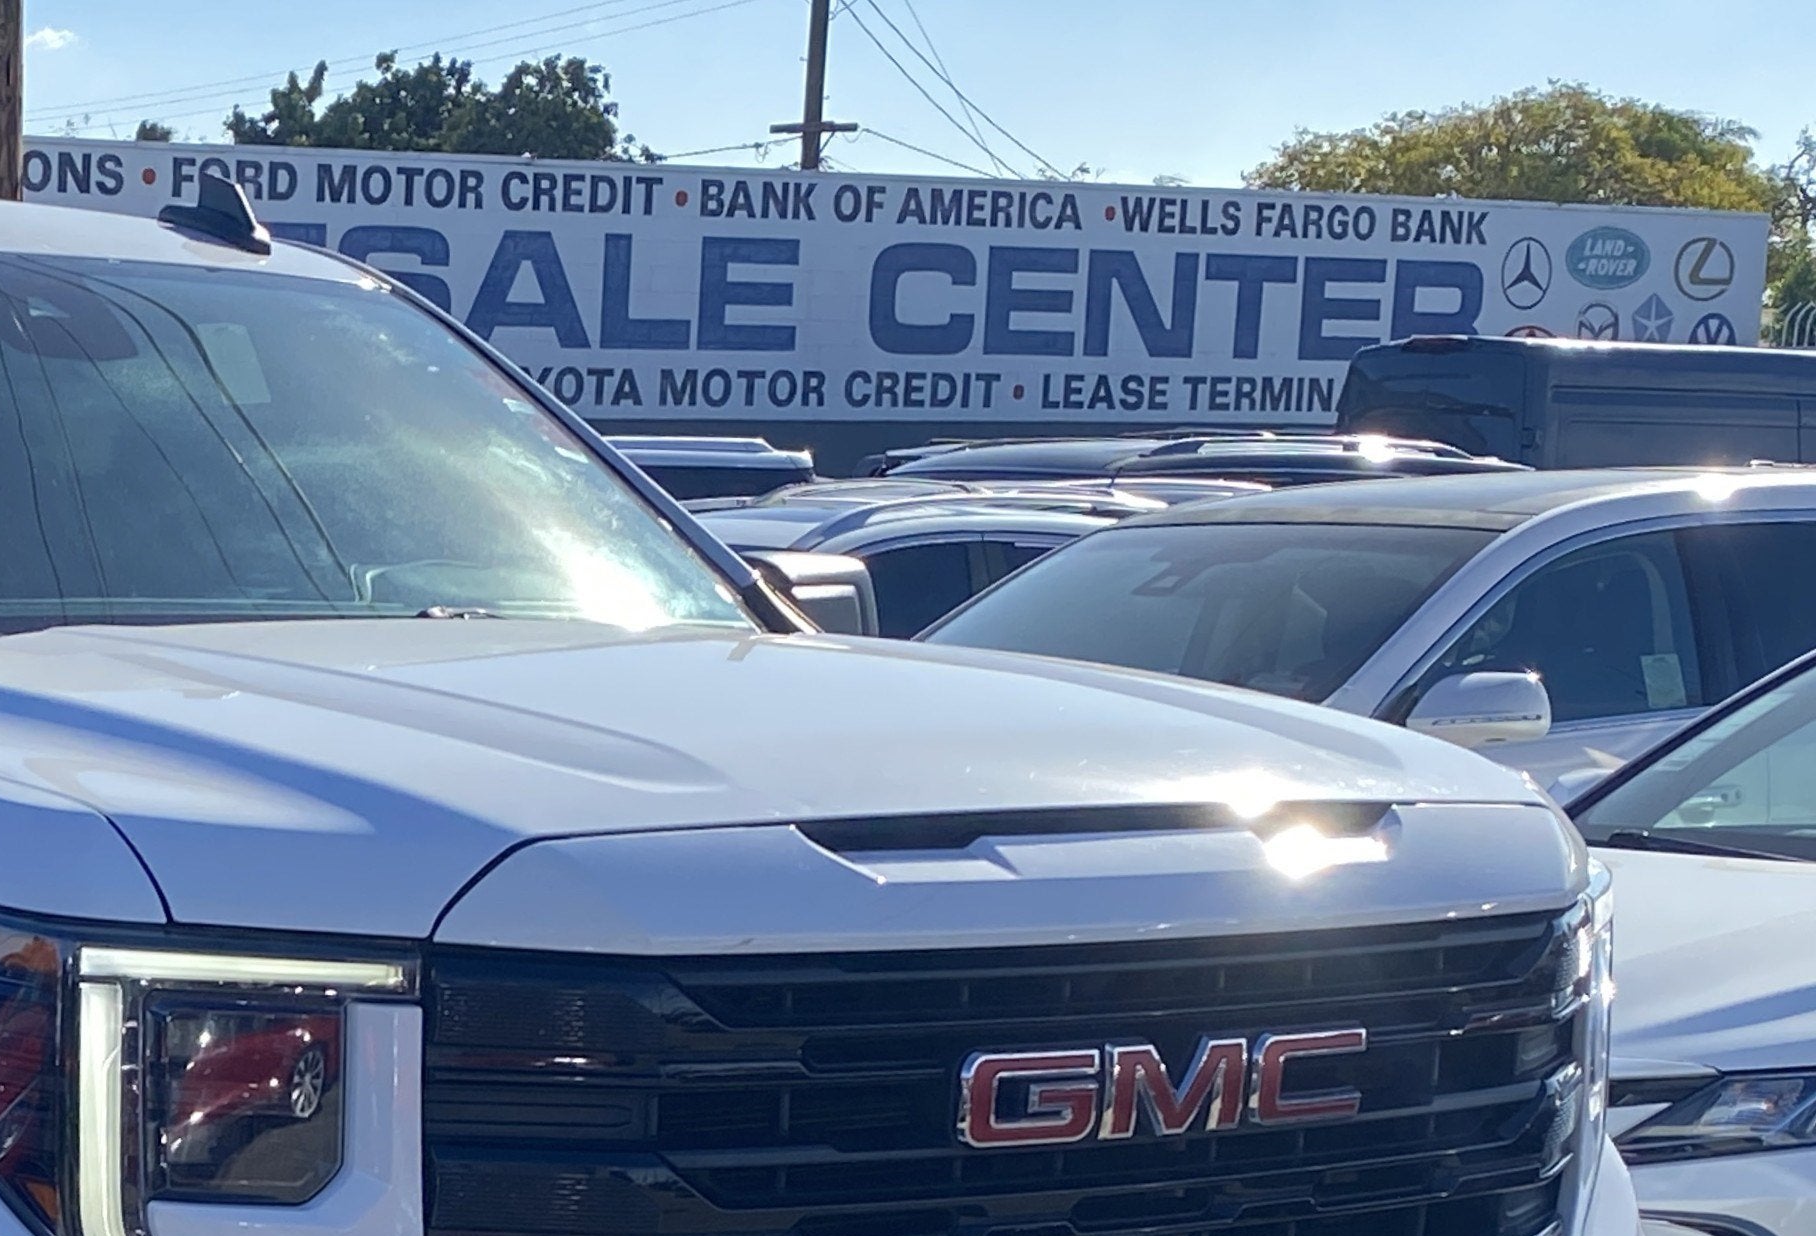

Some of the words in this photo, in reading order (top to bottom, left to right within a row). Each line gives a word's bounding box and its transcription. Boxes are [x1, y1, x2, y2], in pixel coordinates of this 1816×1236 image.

[316, 163, 484, 210] MOTOR
[501, 170, 663, 216] CREDIT
[700, 179, 817, 221] BANK
[834, 184, 886, 223] OF
[896, 187, 1083, 230] AMERICA
[1121, 195, 1242, 237] WELLS
[1256, 202, 1377, 241] FARGO
[1390, 208, 1489, 246] BANK
[262, 222, 801, 352] SALE
[868, 242, 1485, 366] CENTER
[659, 368, 826, 408] MOTOR
[844, 371, 1002, 409] CREDIT
[1042, 373, 1169, 411] LEASE
[1183, 376, 1338, 413] TERMIN
[957, 1027, 1368, 1149] GMC
